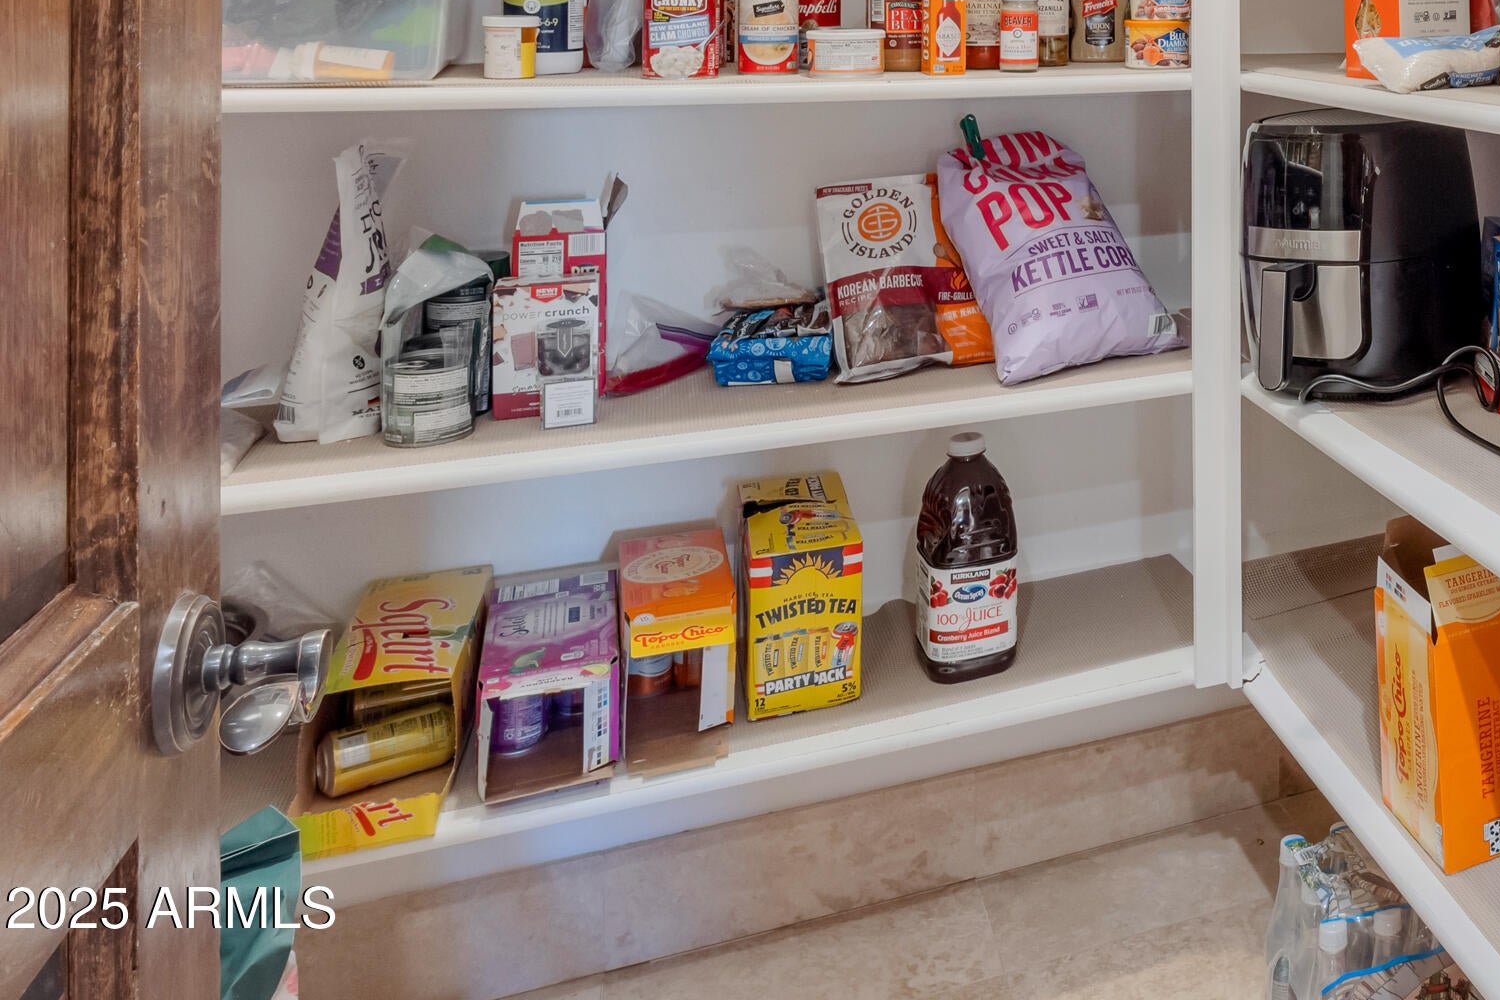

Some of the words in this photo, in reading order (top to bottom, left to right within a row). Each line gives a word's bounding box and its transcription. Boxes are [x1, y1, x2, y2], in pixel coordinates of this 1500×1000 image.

[798, 0, 837, 17] mpbell's
[890, 9, 923, 21] PEA
[667, 22, 707, 30] ENGLAND
[891, 20, 923, 30] BUT
[1004, 15, 1032, 26] BEAVER
[650, 30, 676, 41] CLAM
[677, 27, 707, 38] CHOWDER
[1169, 32, 1186, 41] BLUE
[842, 188, 914, 219] GOLDEN
[975, 181, 1073, 252] POP
[848, 232, 915, 260] ISLAND
[1027, 233, 1070, 258] SWEET
[1073, 231, 1086, 246] &
[1084, 229, 1116, 245] SALTY
[1010, 247, 1094, 293] KETTLE
[836, 278, 878, 300] KOREAN
[878, 273, 924, 290] BARBECUE
[838, 293, 873, 308] RECIPE
[544, 305, 590, 318] crunch
[952, 570, 990, 580] KIRKLAND
[1445, 568, 1494, 589] TANGERIN
[954, 591, 970, 600] Ocean
[969, 590, 984, 600] Spray
[755, 597, 826, 629] TWISTED
[829, 598, 857, 615] TEA
[351, 598, 453, 675] Squirt
[633, 631, 682, 649] Topo
[679, 624, 729, 641] Chico
[937, 632, 968, 642] Cranberry
[968, 630, 983, 639] Juice
[983, 626, 1000, 636] Blend
[765, 673, 812, 695] PARTY
[813, 666, 846, 686] PACK
[842, 681, 856, 693] 5%
[754, 697, 766, 707] 12
[1477, 696, 1495, 800] TANGERINE
